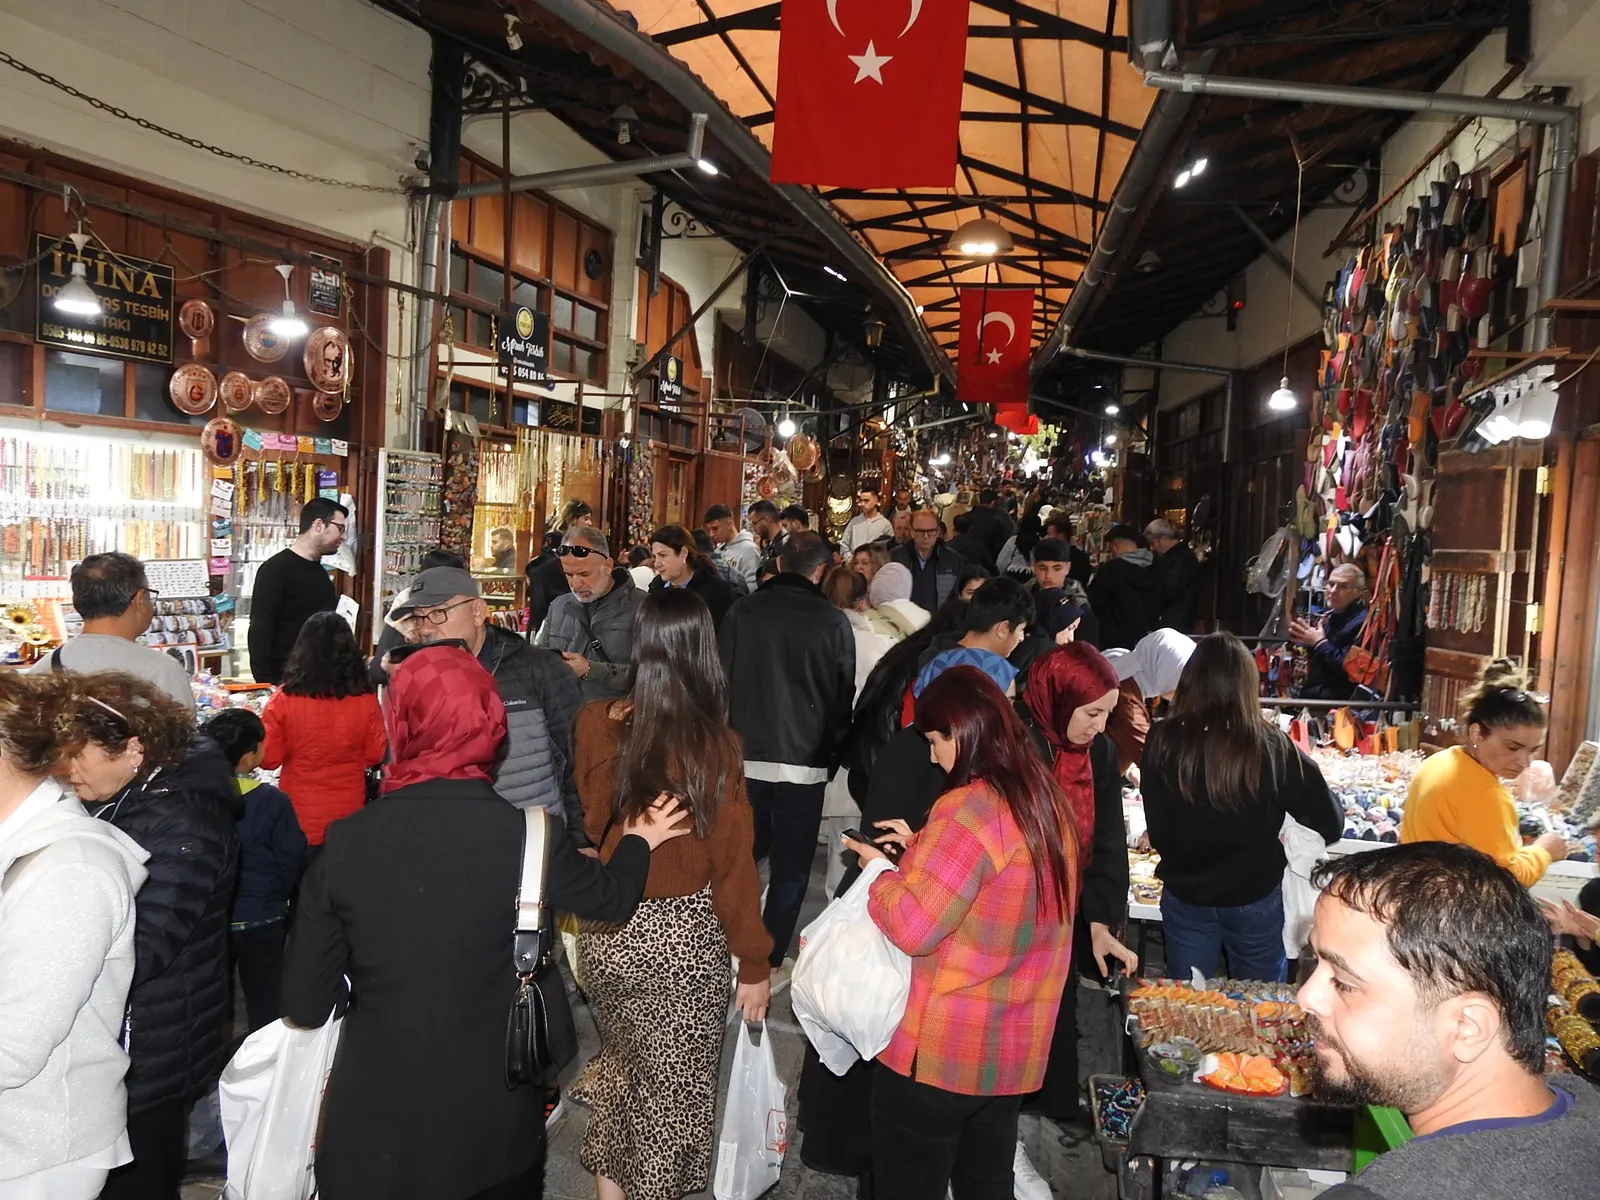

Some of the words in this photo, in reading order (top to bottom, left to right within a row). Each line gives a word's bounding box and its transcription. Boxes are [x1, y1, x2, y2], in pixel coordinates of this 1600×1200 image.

[124, 300, 169, 321] TESBİH
[101, 315, 130, 331] TAKI
[502, 699, 527, 707] Columbia
